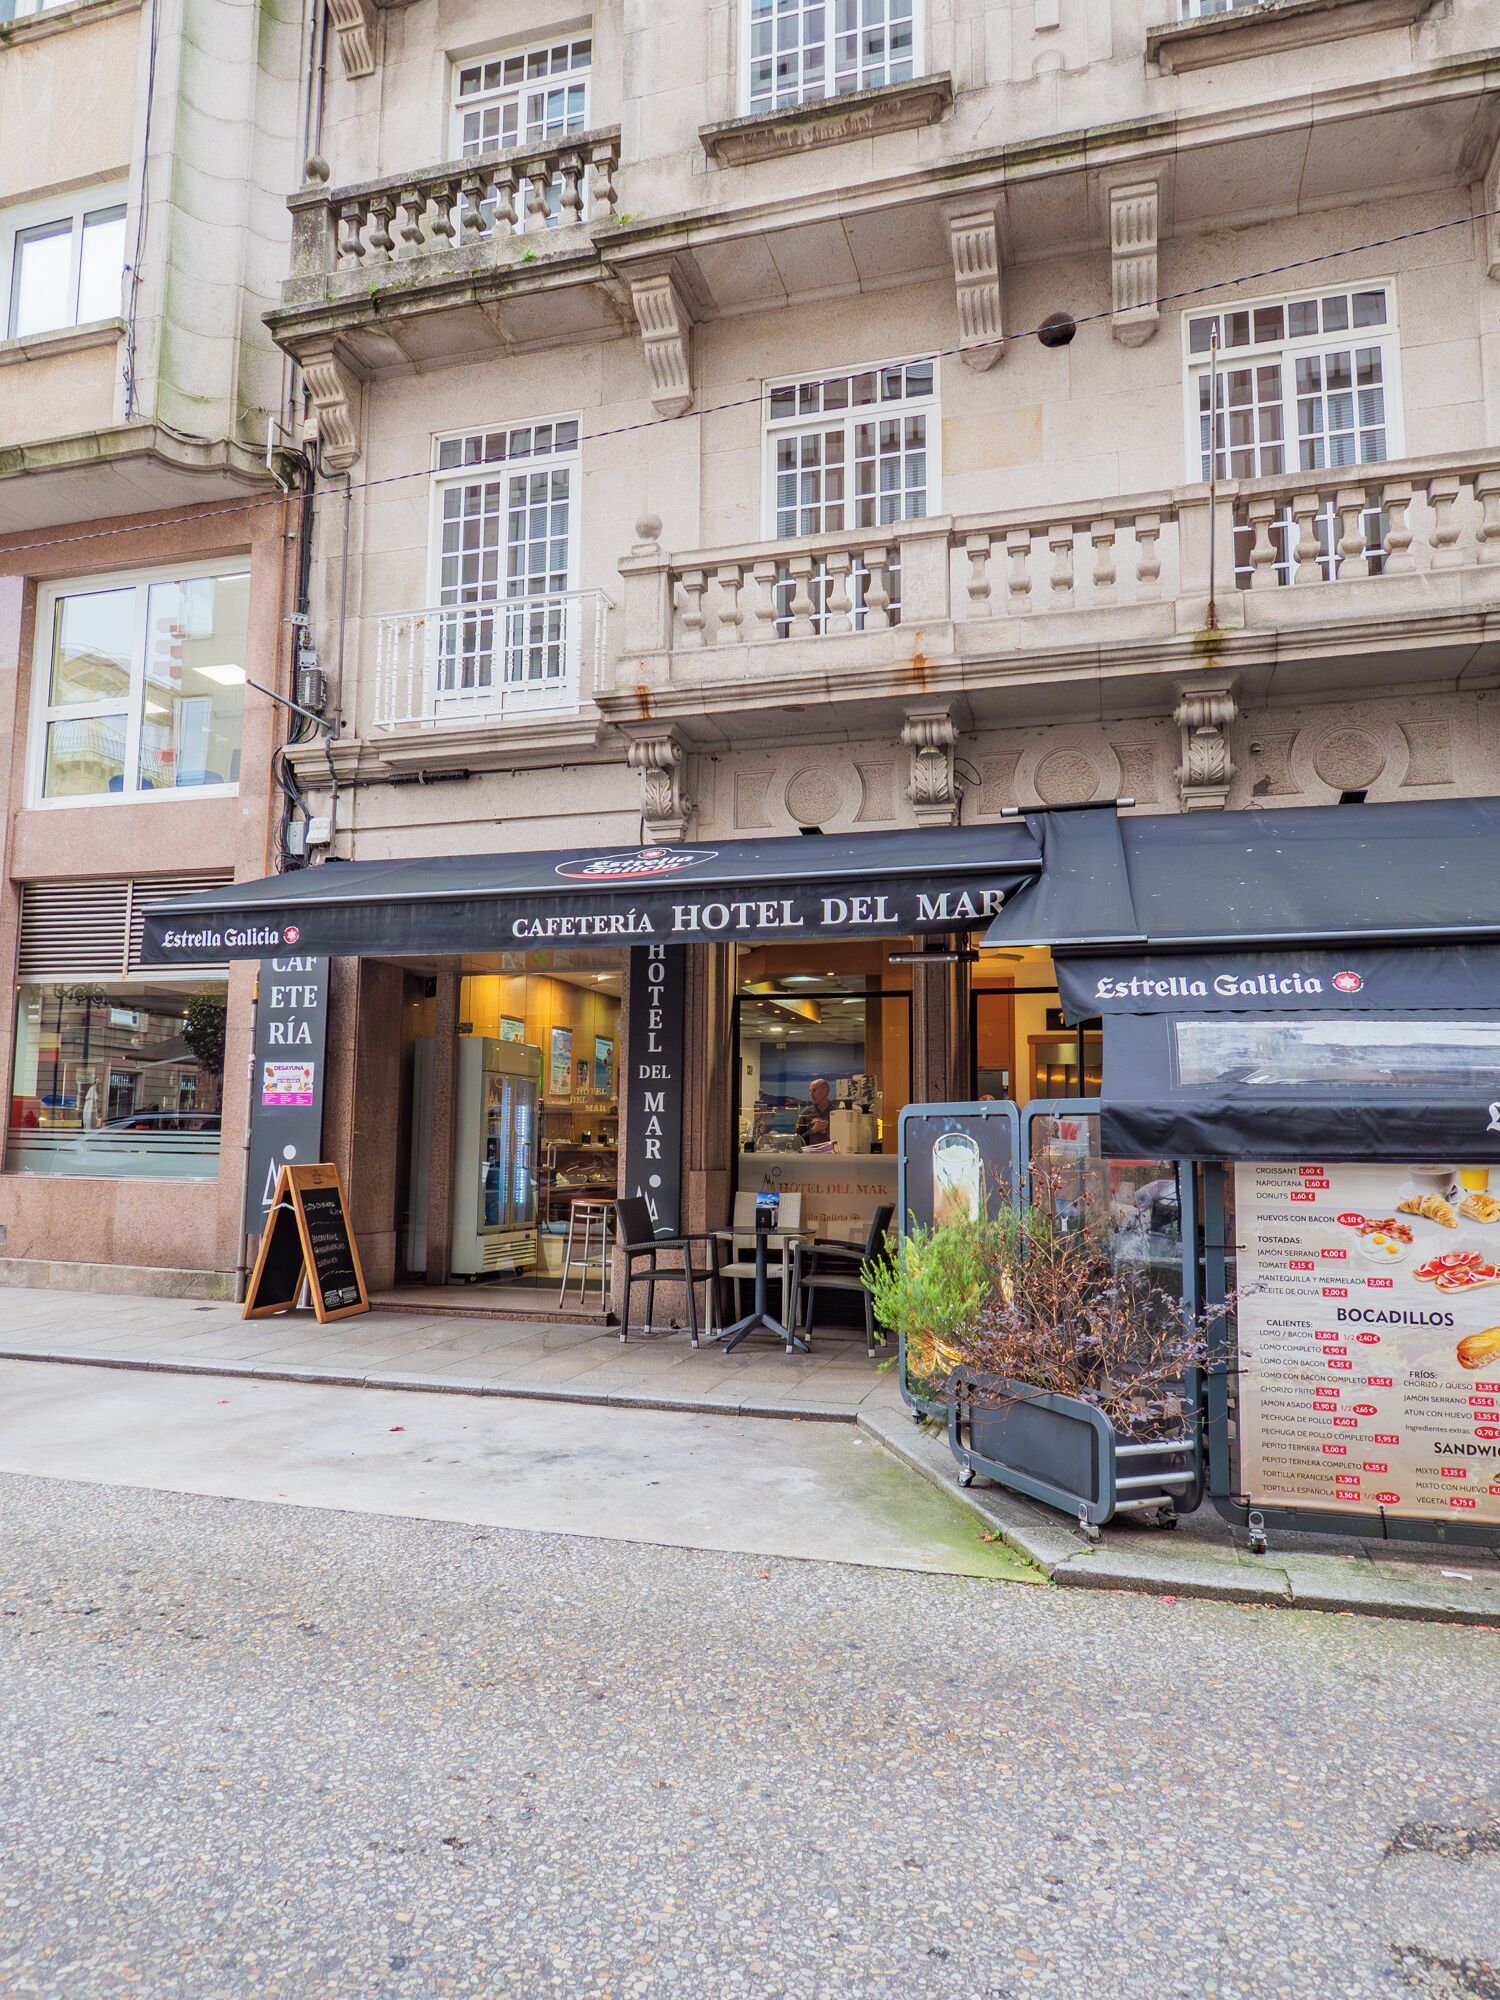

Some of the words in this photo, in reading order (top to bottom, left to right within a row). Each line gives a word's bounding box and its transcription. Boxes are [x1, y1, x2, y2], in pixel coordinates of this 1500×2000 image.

[587, 855, 695, 869] Estrella
[583, 862, 679, 875] Galicia
[512, 908, 655, 938] CAFETERÍA
[671, 900, 804, 932] HOTEL
[820, 896, 898, 925] DEL
[916, 889, 1005, 921] MAR
[162, 930, 221, 948] Estrella
[224, 926, 279, 946] Galicia
[1094, 975, 1209, 999] Estrella
[1213, 972, 1324, 997] Galicia
[270, 985, 318, 1009] ETE
[647, 944, 666, 1053] HOTEL
[268, 1015, 313, 1045] RÍA
[638, 1064, 671, 1079] DEL
[643, 1091, 666, 1159] MAR
[1256, 1167, 1298, 1175] CROISSANT
[1256, 1192, 1289, 1200] DONUTS
[1257, 1214, 1289, 1222] HUEVOS
[1257, 1236, 1303, 1244] TOSTADAS:
[1285, 1250, 1320, 1258] SERRANO
[1258, 1275, 1311, 1283] MANTEQUILLA
[1319, 1277, 1367, 1285] MERMELADA
[1259, 1287, 1284, 1295] ACEITE
[1297, 1288, 1319, 1296] OLIVA
[1337, 1308, 1454, 1327] BOCADILLOS
[1266, 1319, 1313, 1328] CALIENTES:
[1282, 1344, 1321, 1353] COMPLETO
[1300, 1359, 1326, 1367] BACON
[1300, 1374, 1326, 1382] BACON
[1327, 1375, 1367, 1384] COMPLETO
[1260, 1385, 1293, 1394] CHORIZO
[1294, 1387, 1316, 1395] FRITO
[1403, 1380, 1438, 1388] CHORIZO
[1445, 1383, 1473, 1391] QUESO
[1286, 1401, 1312, 1409] ASADO
[1430, 1396, 1467, 1404] SERRANO
[1261, 1414, 1295, 1422] PECHUGA
[1308, 1417, 1332, 1425] POLLO
[1426, 1410, 1443, 1418] CON
[1444, 1411, 1473, 1419] HUEVO
[1405, 1424, 1448, 1433] Ingredientes
[1261, 1428, 1295, 1436] PECHUGA
[1296, 1430, 1307, 1438] DE
[1308, 1431, 1333, 1439] POLLO
[1333, 1433, 1373, 1442] COMPLETO
[1261, 1442, 1287, 1450] PEPITO
[1288, 1443, 1320, 1452] TERNERA
[1434, 1441, 1500, 1458] SANDWI
[1262, 1456, 1287, 1464] PEPITO
[1289, 1457, 1320, 1466] TERNERA
[1322, 1460, 1362, 1470] COMPLETO
[1262, 1470, 1295, 1479] TORTILLA
[1296, 1472, 1334, 1481] FRANCESA
[1415, 1467, 1440, 1475] MIXTO
[1262, 1484, 1295, 1493] TORTILLA
[1297, 1486, 1335, 1496] ESPAÑOLA
[1415, 1482, 1440, 1490] MIXTO
[1459, 1485, 1488, 1493] HUEVO
[1416, 1496, 1449, 1505] VEGETAL
